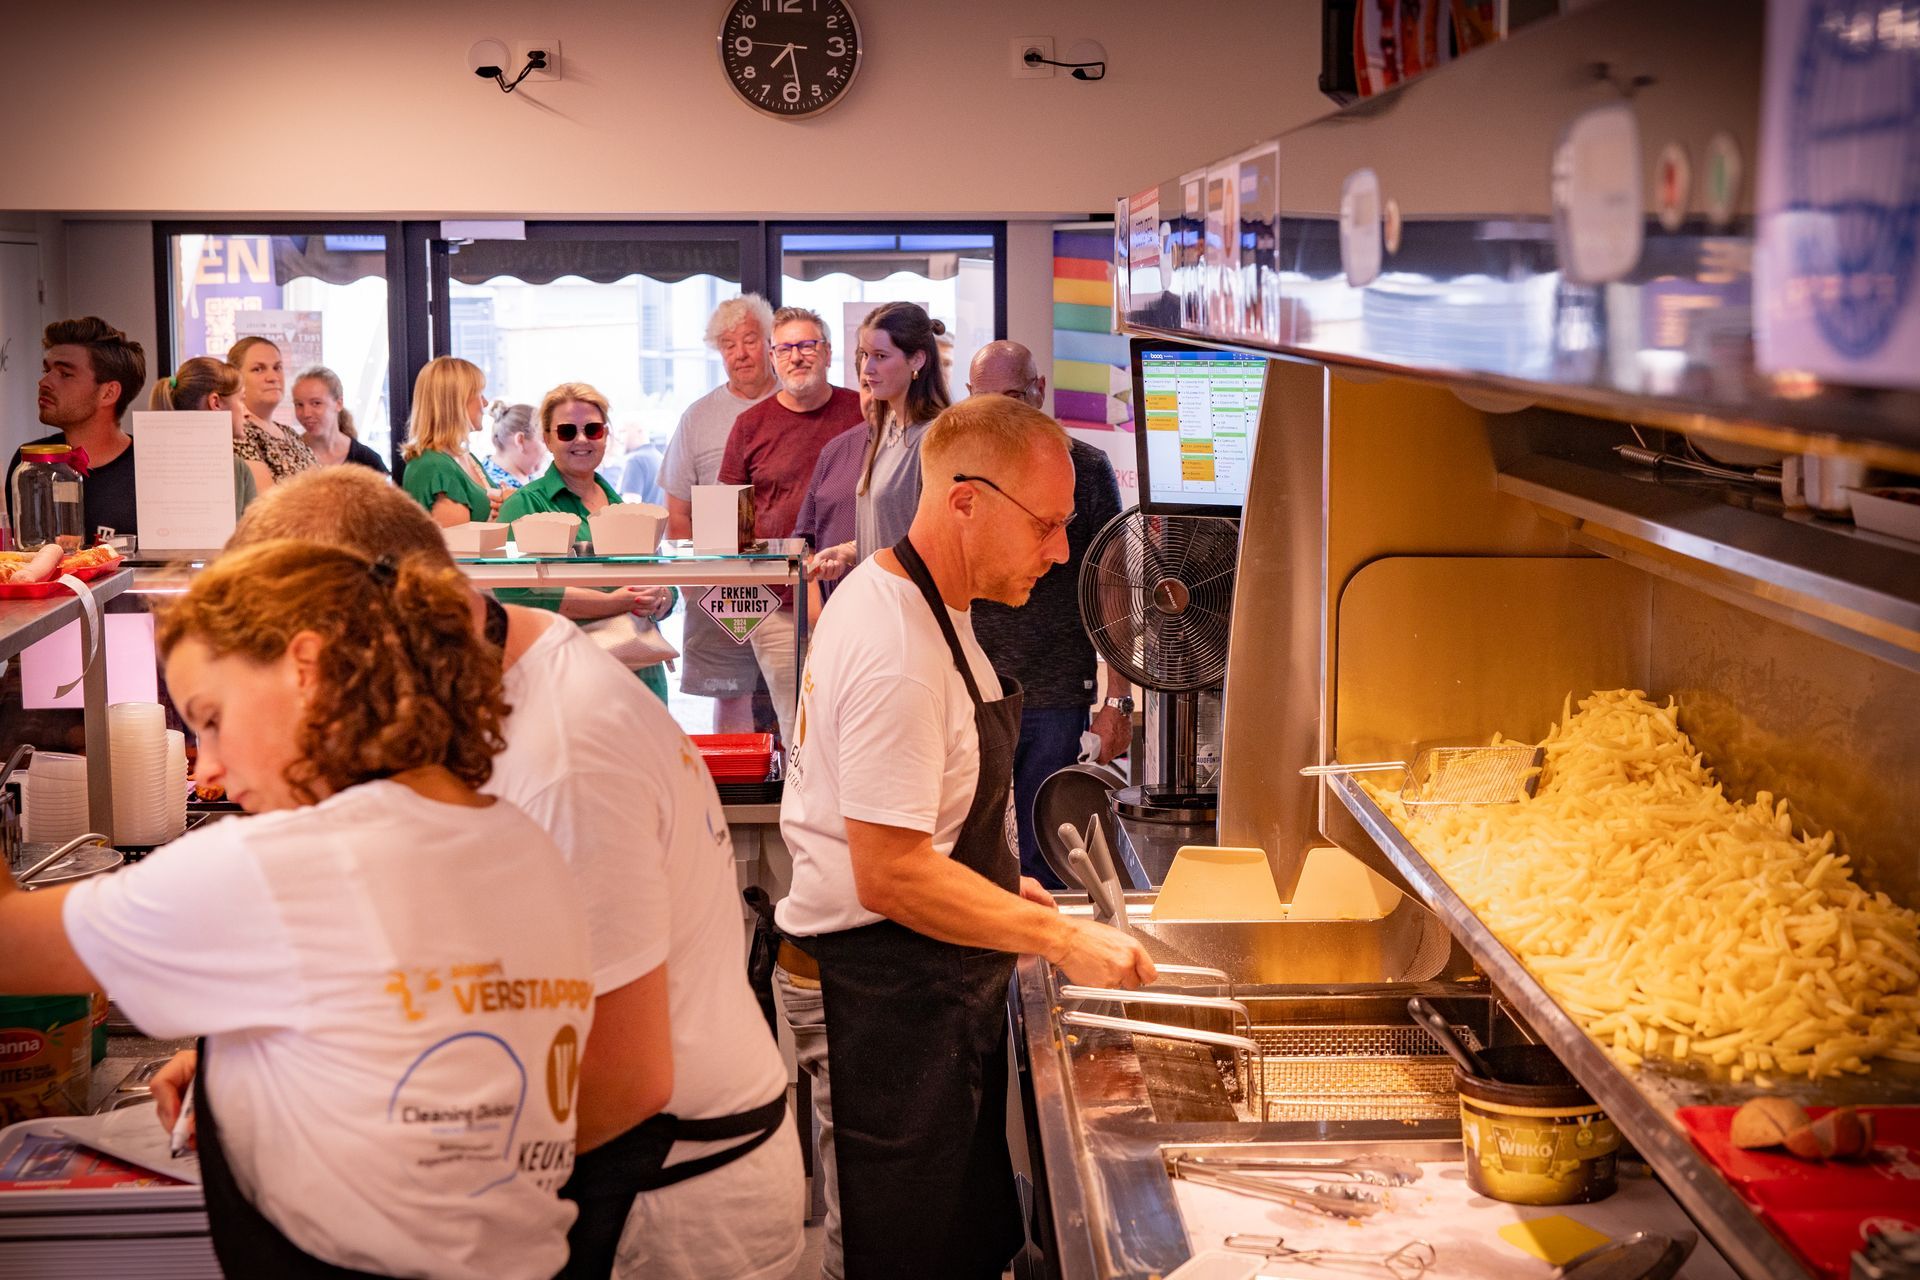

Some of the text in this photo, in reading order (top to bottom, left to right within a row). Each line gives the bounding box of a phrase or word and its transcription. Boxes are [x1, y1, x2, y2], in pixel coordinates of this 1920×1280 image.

[742, 14, 757, 29] 10
[826, 15, 838, 29] 2
[734, 36, 753, 57] 9
[826, 36, 847, 57] 3
[743, 66, 756, 79] 8
[826, 66, 839, 78] 4
[761, 84, 771, 97] 7
[782, 81, 801, 103] 6
[811, 84, 821, 97] 5
[721, 586, 759, 599] ERKEND
